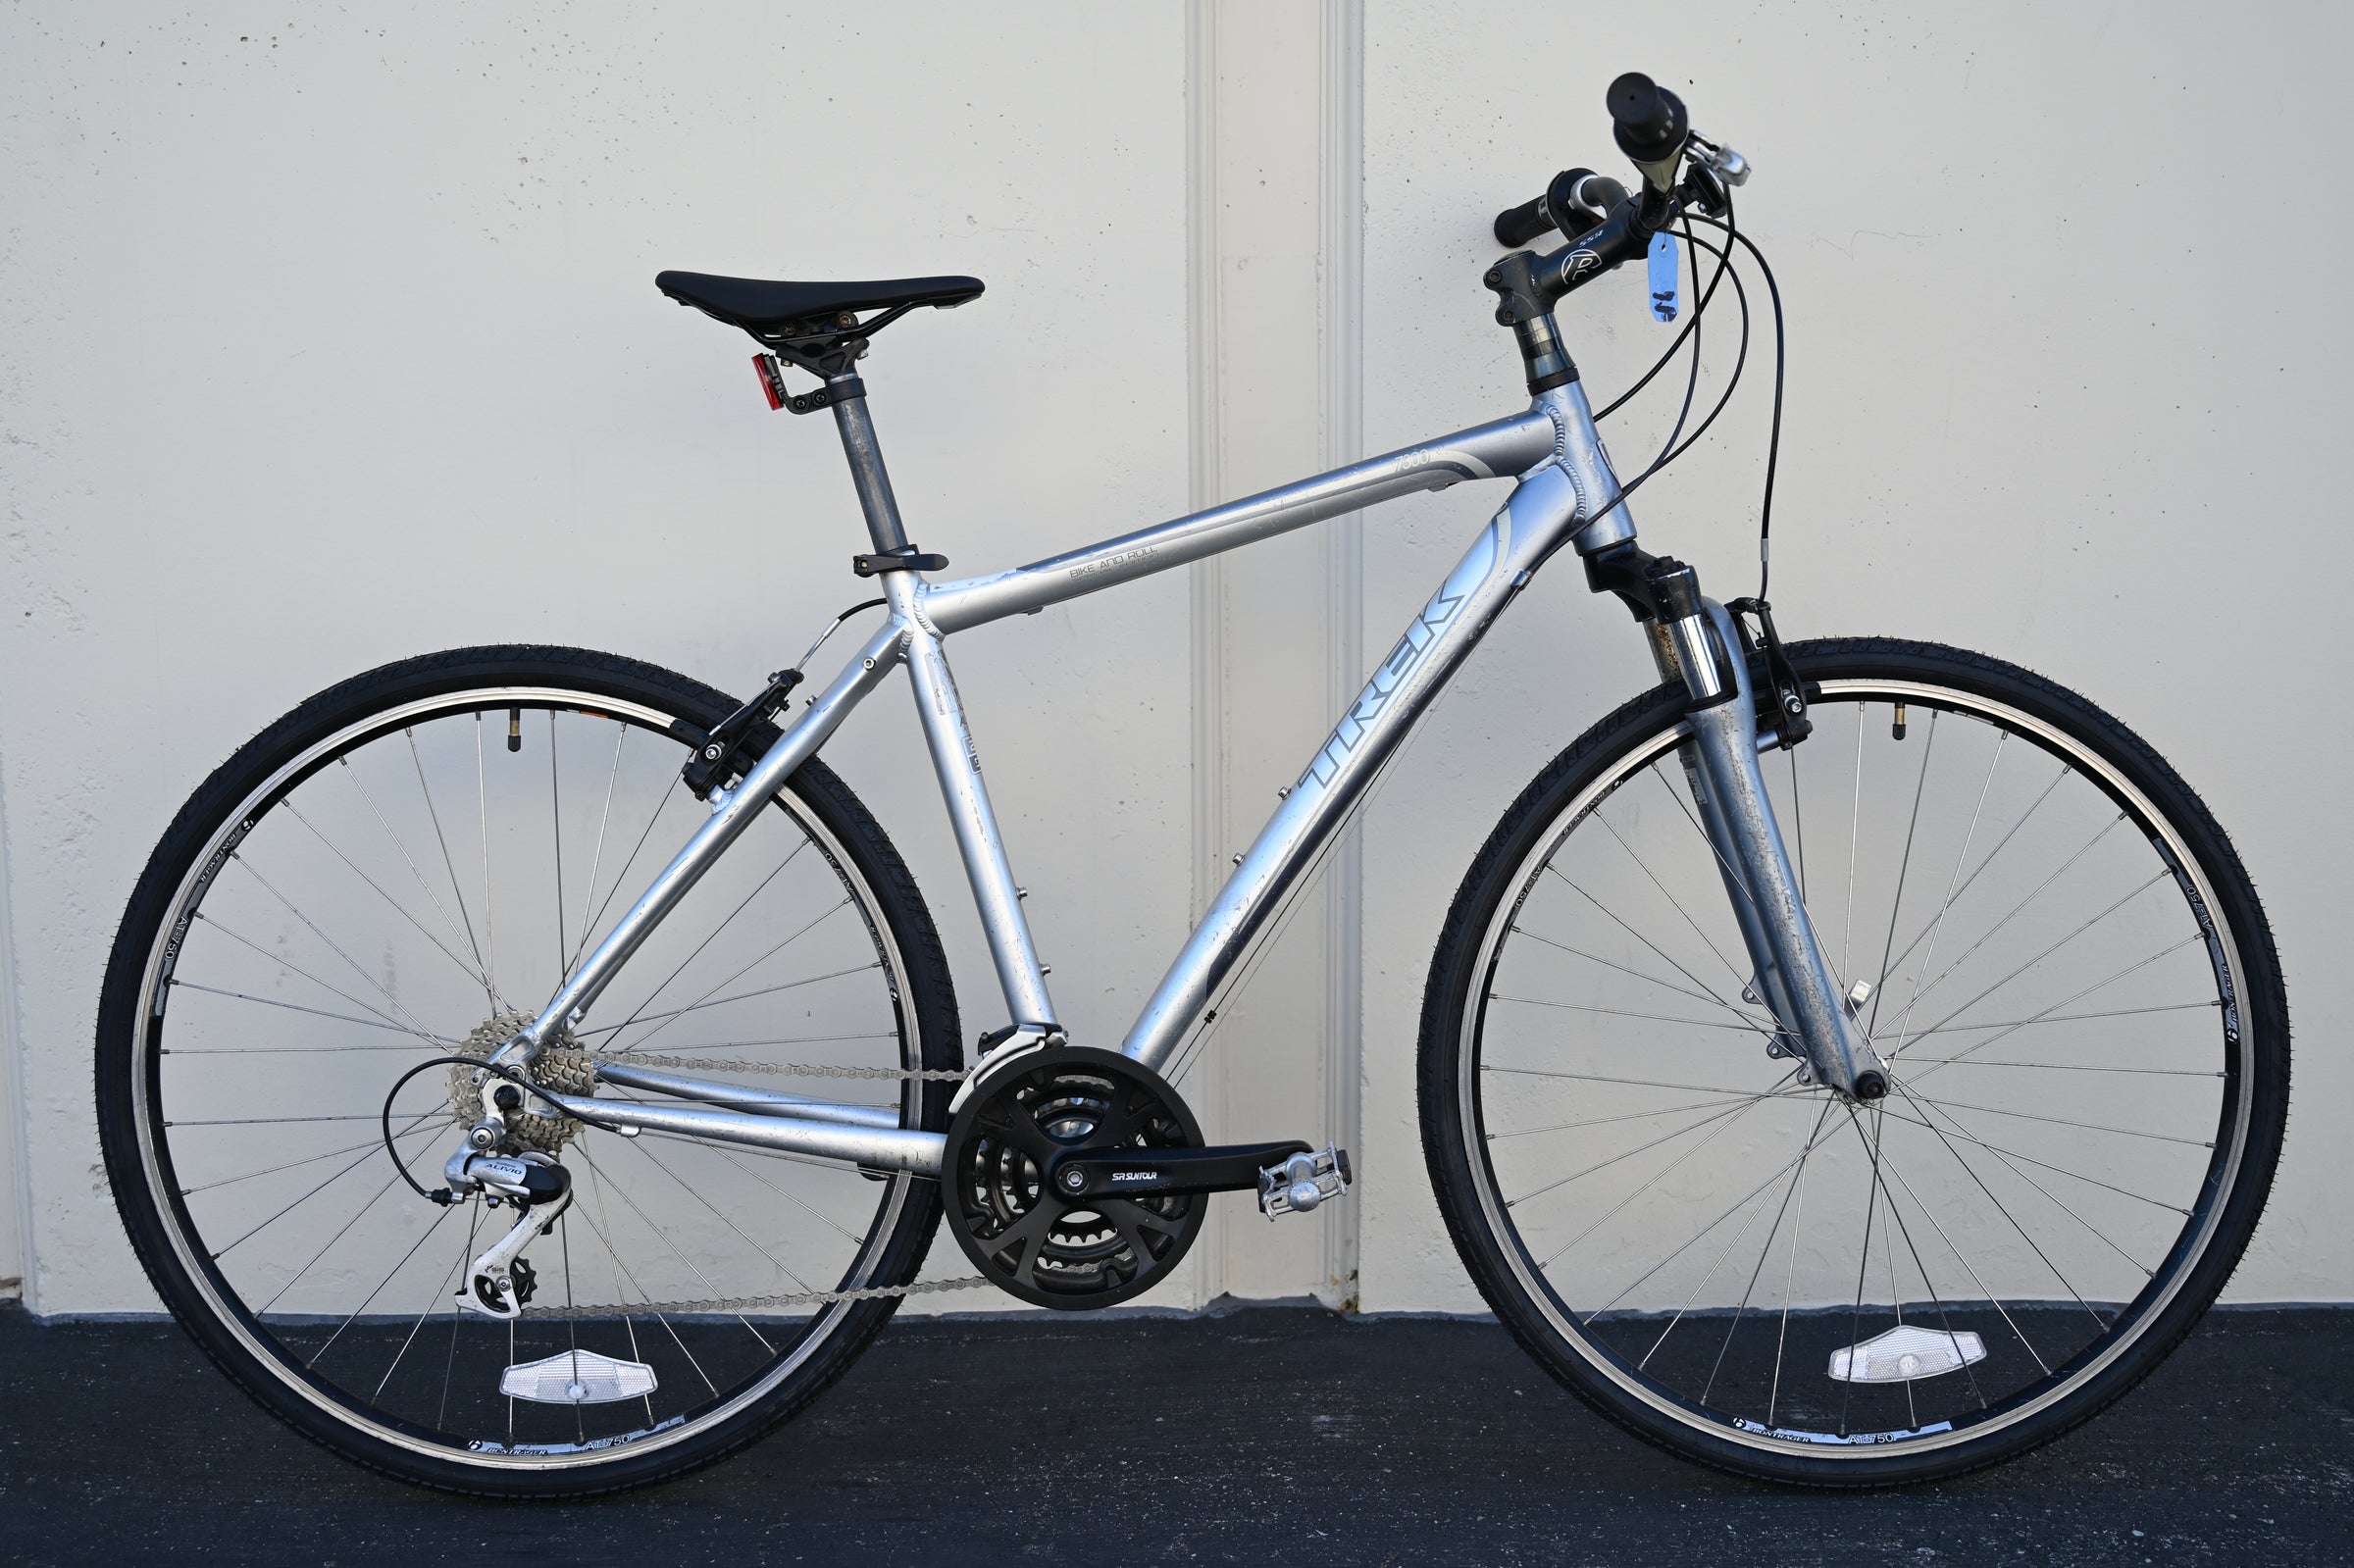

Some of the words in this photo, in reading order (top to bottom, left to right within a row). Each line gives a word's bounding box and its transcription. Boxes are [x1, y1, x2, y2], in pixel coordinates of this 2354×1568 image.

[1069, 564, 1096, 579] BIKE
[1099, 555, 1124, 570] AND
[1127, 546, 1158, 561] ROLL
[1297, 579, 1465, 789] TREK
[165, 916, 188, 959] AT-750
[486, 1163, 523, 1175] ALIVIO
[1111, 1172, 1125, 1181] SR
[1125, 1172, 1157, 1181] SUNTOUR
[586, 1435, 630, 1450] AT-750
[1752, 1427, 1810, 1443] BONTRAGER
[1849, 1433, 1894, 1444] AT-750
